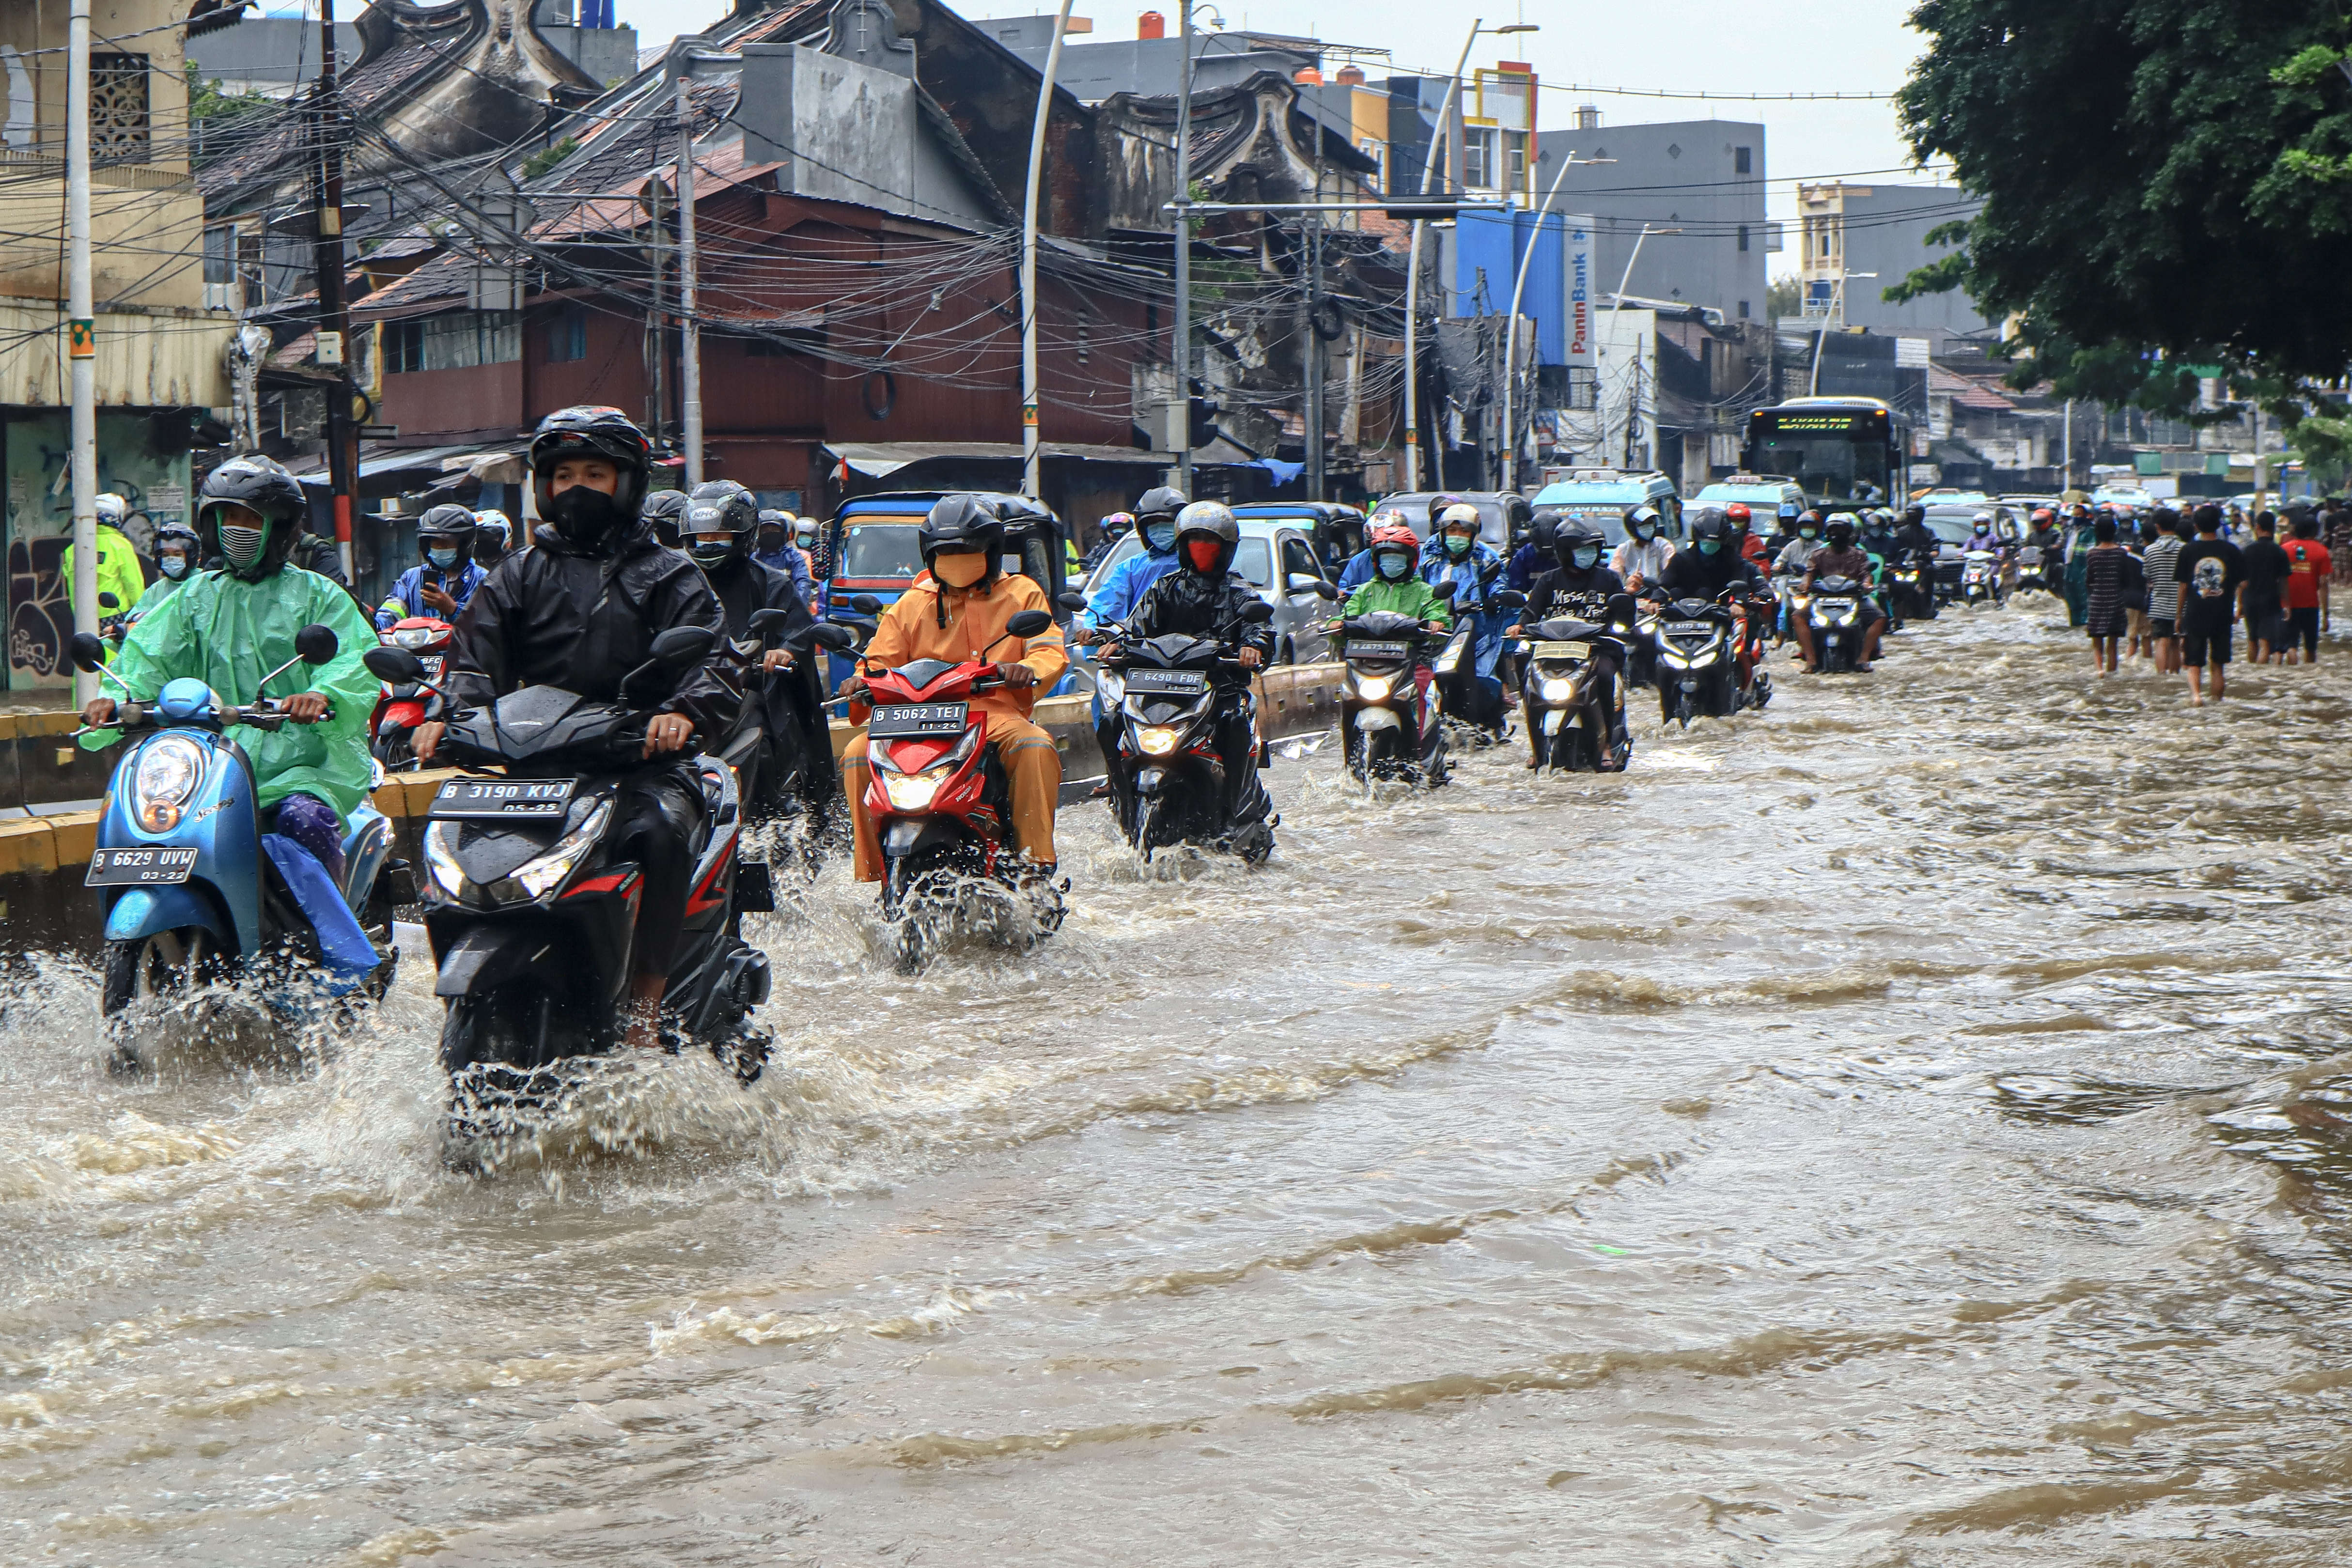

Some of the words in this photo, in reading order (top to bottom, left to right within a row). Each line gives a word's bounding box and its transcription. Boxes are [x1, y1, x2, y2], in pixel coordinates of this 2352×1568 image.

[1571, 252, 1587, 354] PaninBank
[1145, 673, 1171, 682] 6490
[1180, 674, 1200, 683] FDF
[876, 711, 885, 722] B
[893, 708, 928, 720] 5062
[936, 707, 960, 717] TEI
[443, 786, 458, 798] B
[469, 786, 518, 798] 3190
[527, 785, 568, 797] KVJ
[94, 854, 105, 868] B
[112, 852, 153, 866] 6629
[159, 851, 193, 865] UVW
